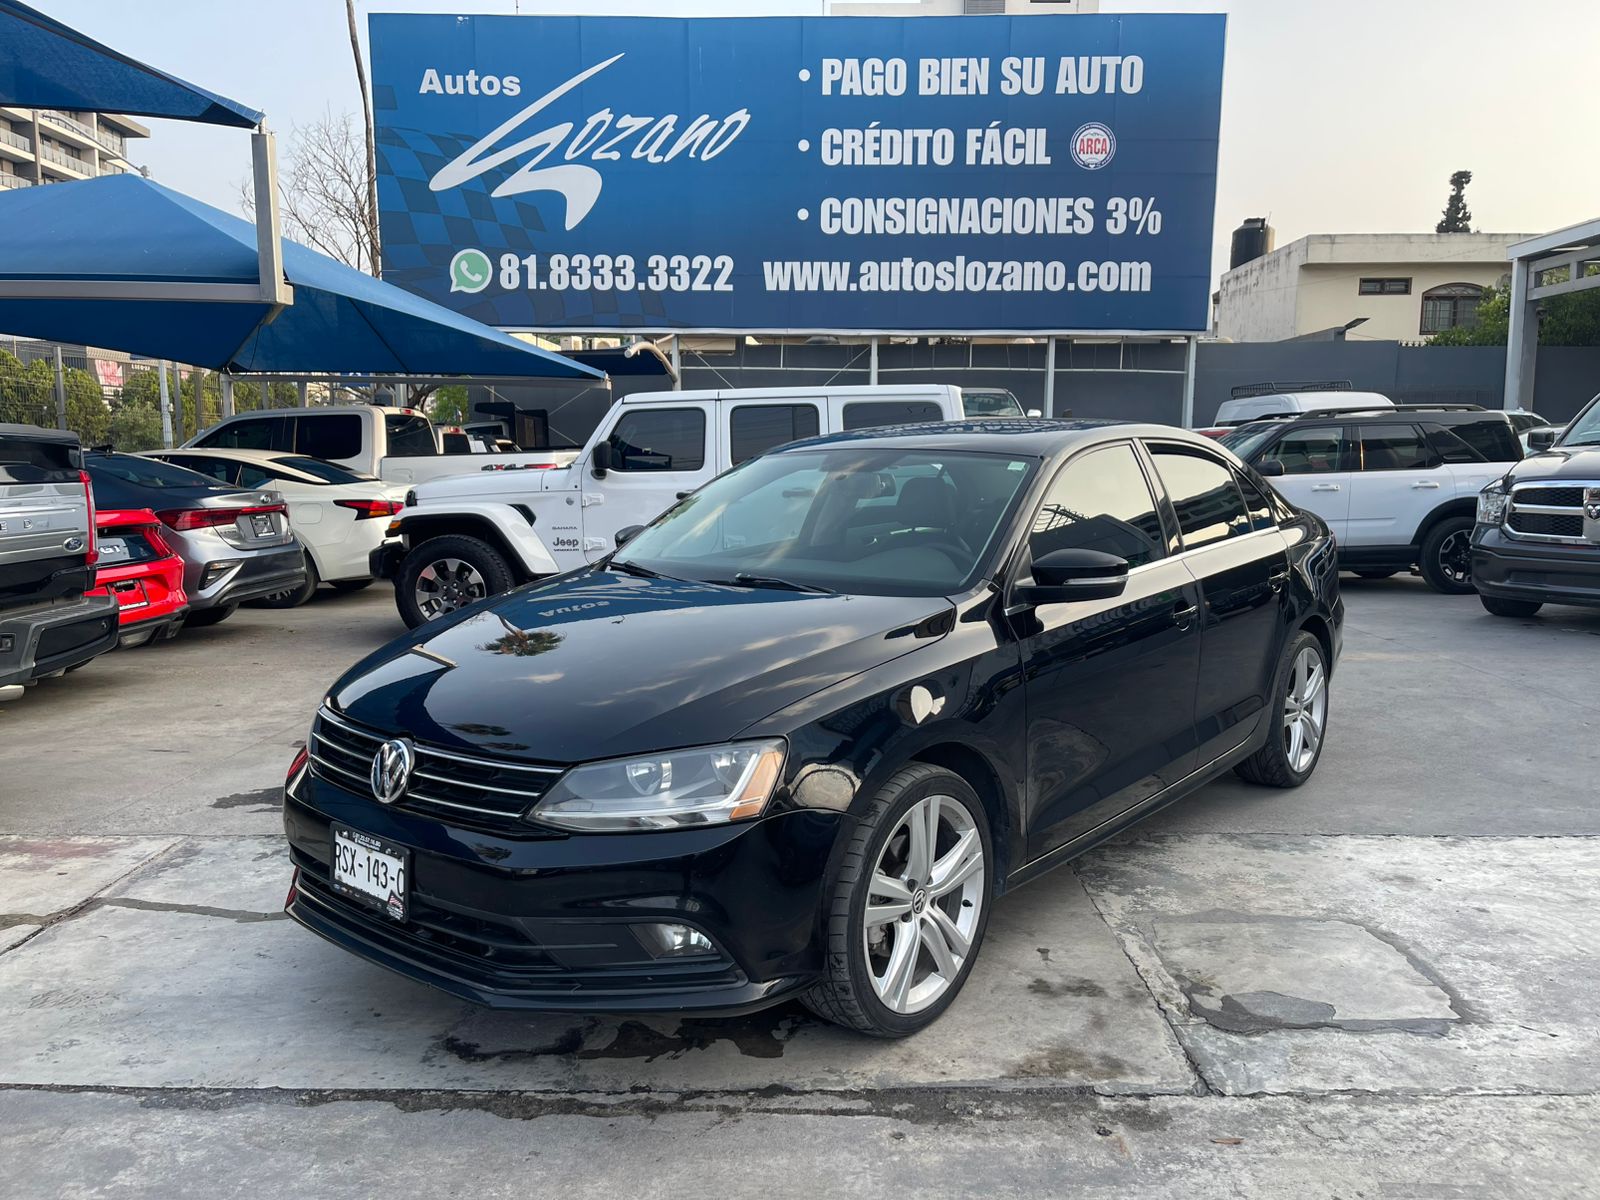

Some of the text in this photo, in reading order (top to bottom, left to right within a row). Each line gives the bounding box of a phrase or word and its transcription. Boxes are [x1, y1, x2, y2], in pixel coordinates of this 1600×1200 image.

[419, 69, 522, 97] Autos
[821, 55, 1145, 97] PAGO BIEN SU AUTO
[429, 52, 751, 232] Lozano
[821, 121, 955, 166] CRÉDITO
[966, 120, 1051, 166] FÁCIL
[1078, 138, 1108, 155] ARCA
[820, 196, 1162, 236] CONSIGNACIONES 3%
[499, 253, 735, 292] 81.8333.3322
[762, 255, 1152, 292] www.autoslozano.com
[553, 537, 579, 547] Jeep
